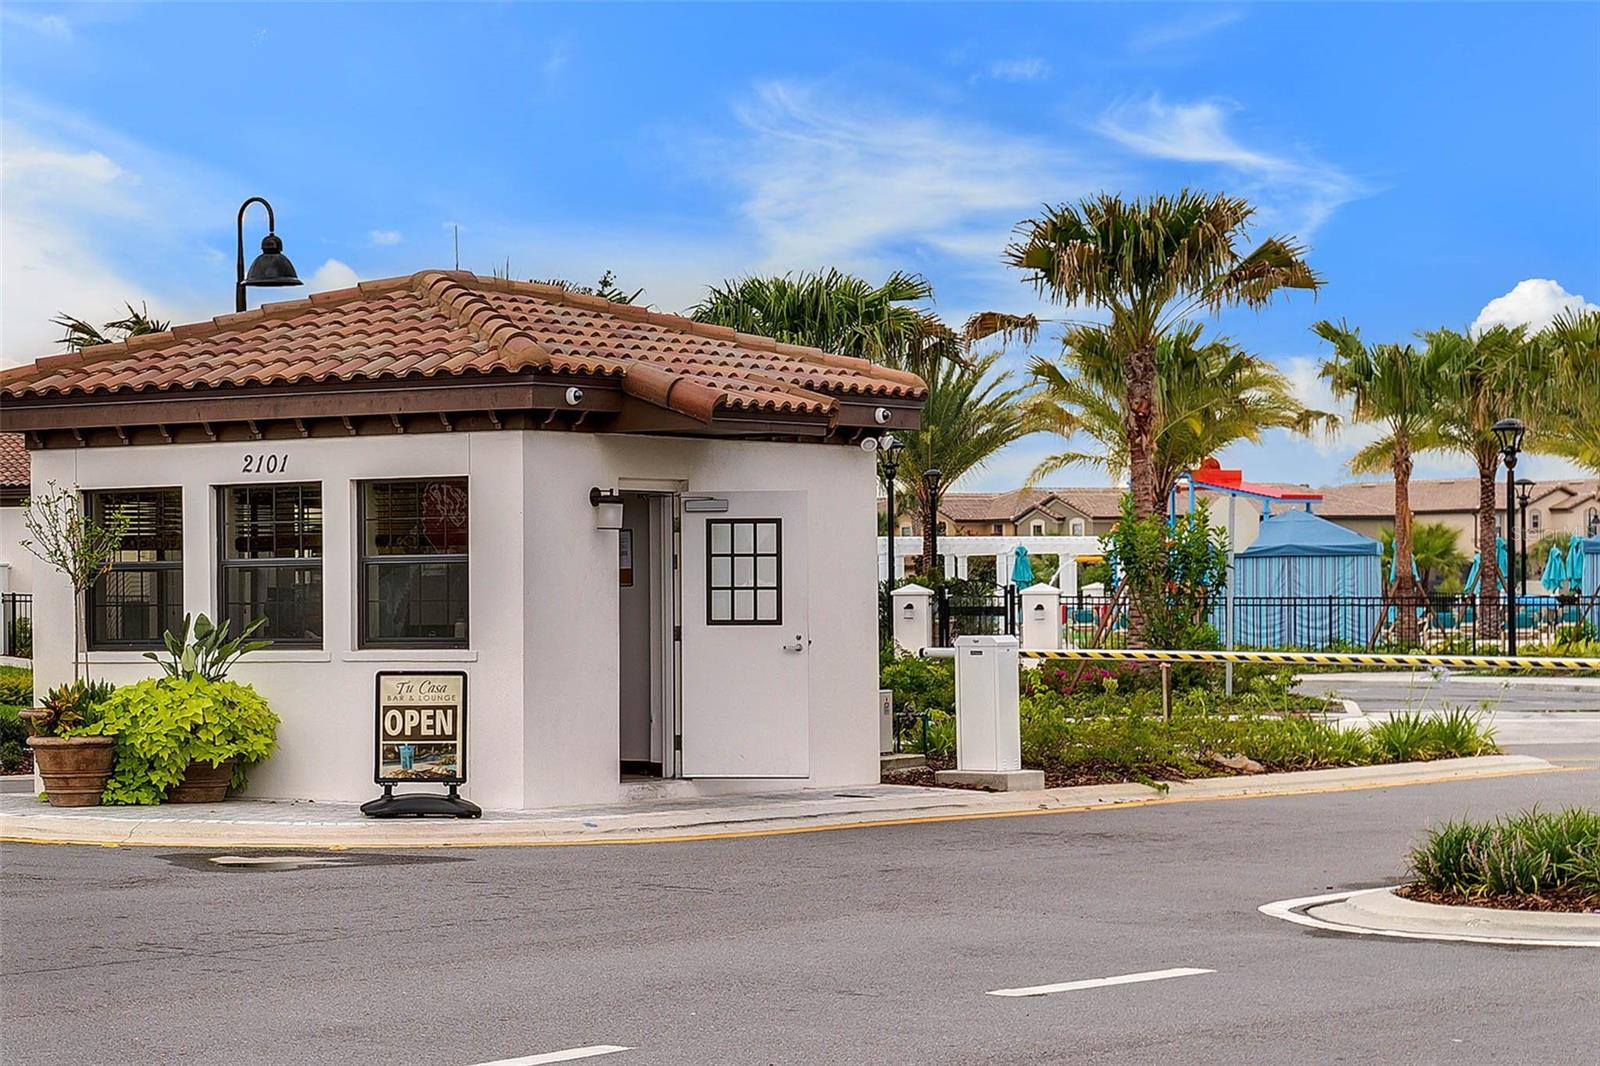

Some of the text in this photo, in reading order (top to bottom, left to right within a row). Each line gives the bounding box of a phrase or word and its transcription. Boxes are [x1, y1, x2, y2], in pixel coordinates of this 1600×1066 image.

[242, 454, 288, 474] 2101
[396, 680, 448, 695] Tu Casa
[418, 694, 456, 702] LOUNGE
[384, 709, 453, 737] OPEN
